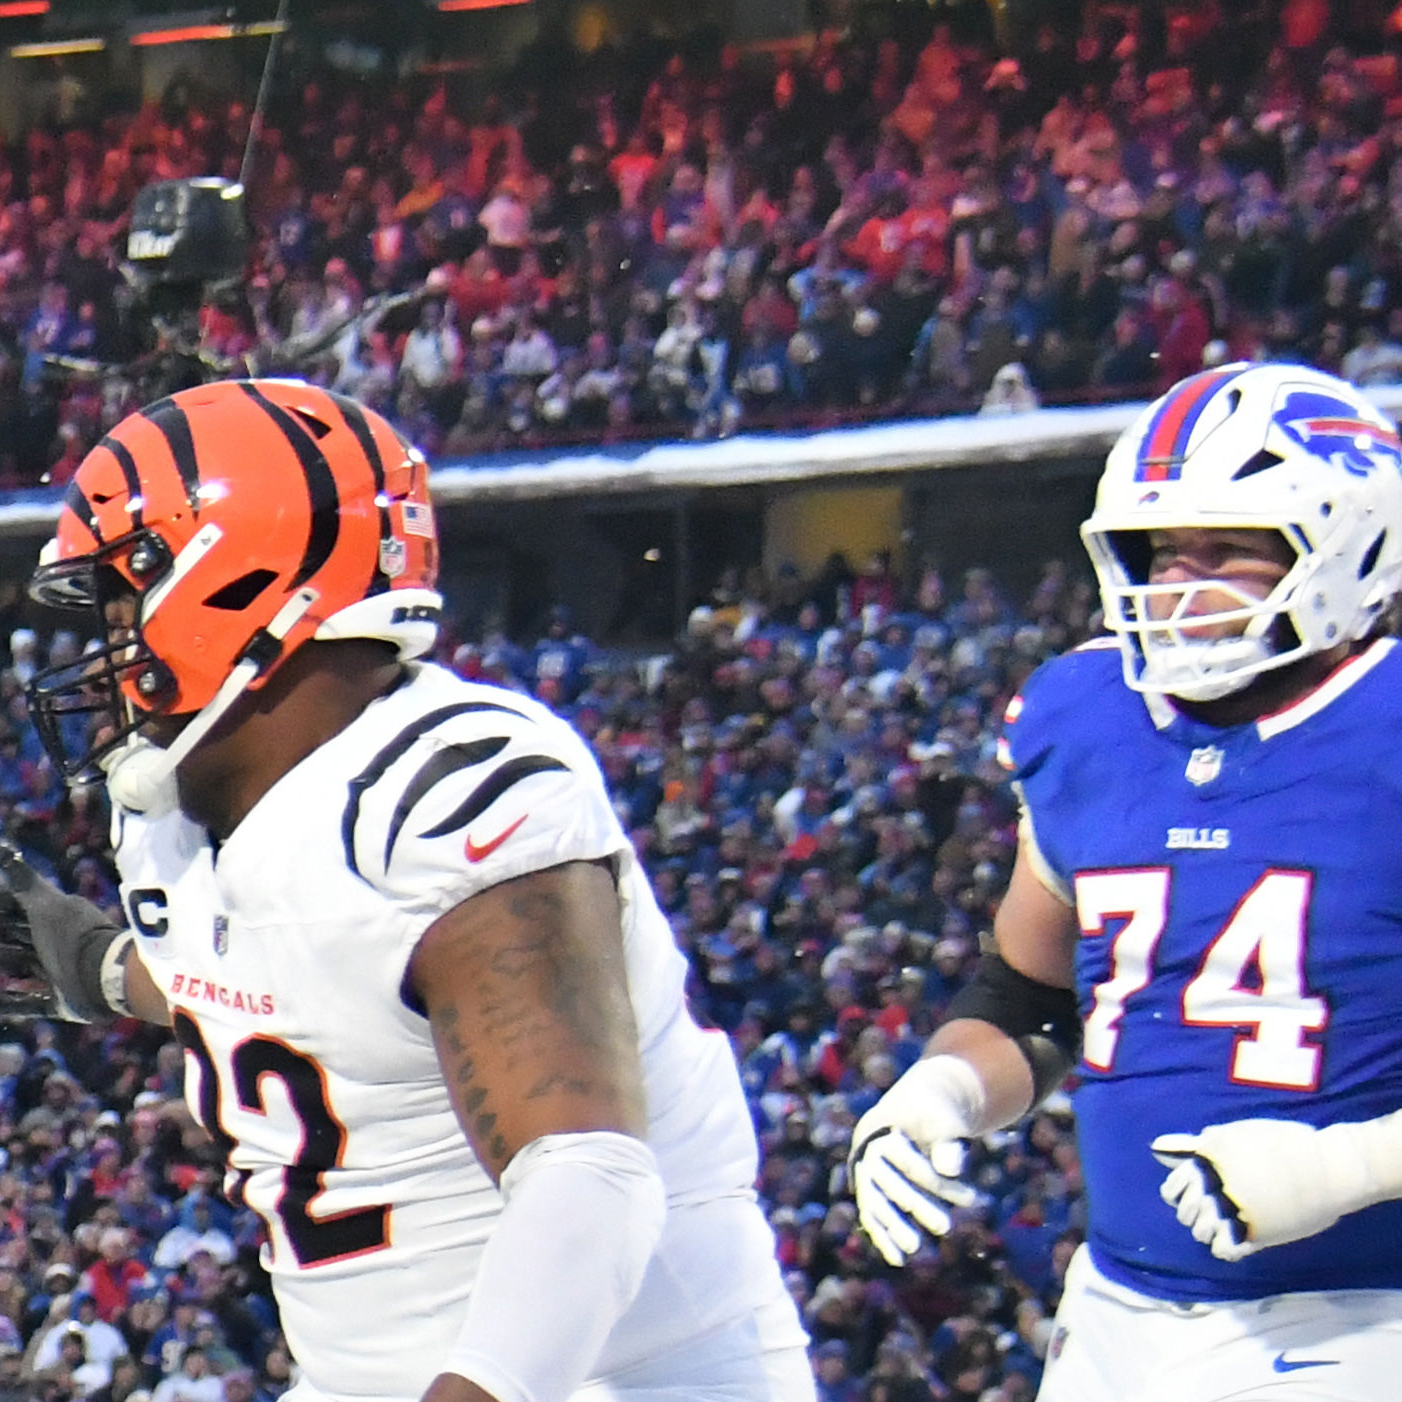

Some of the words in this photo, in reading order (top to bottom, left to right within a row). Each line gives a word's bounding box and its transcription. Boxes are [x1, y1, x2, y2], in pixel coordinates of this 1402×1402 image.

[1166, 828, 1230, 849] BILLS
[128, 888, 169, 938] C
[170, 974, 275, 1016] BENGALS
[1074, 867, 1330, 1092] 74
